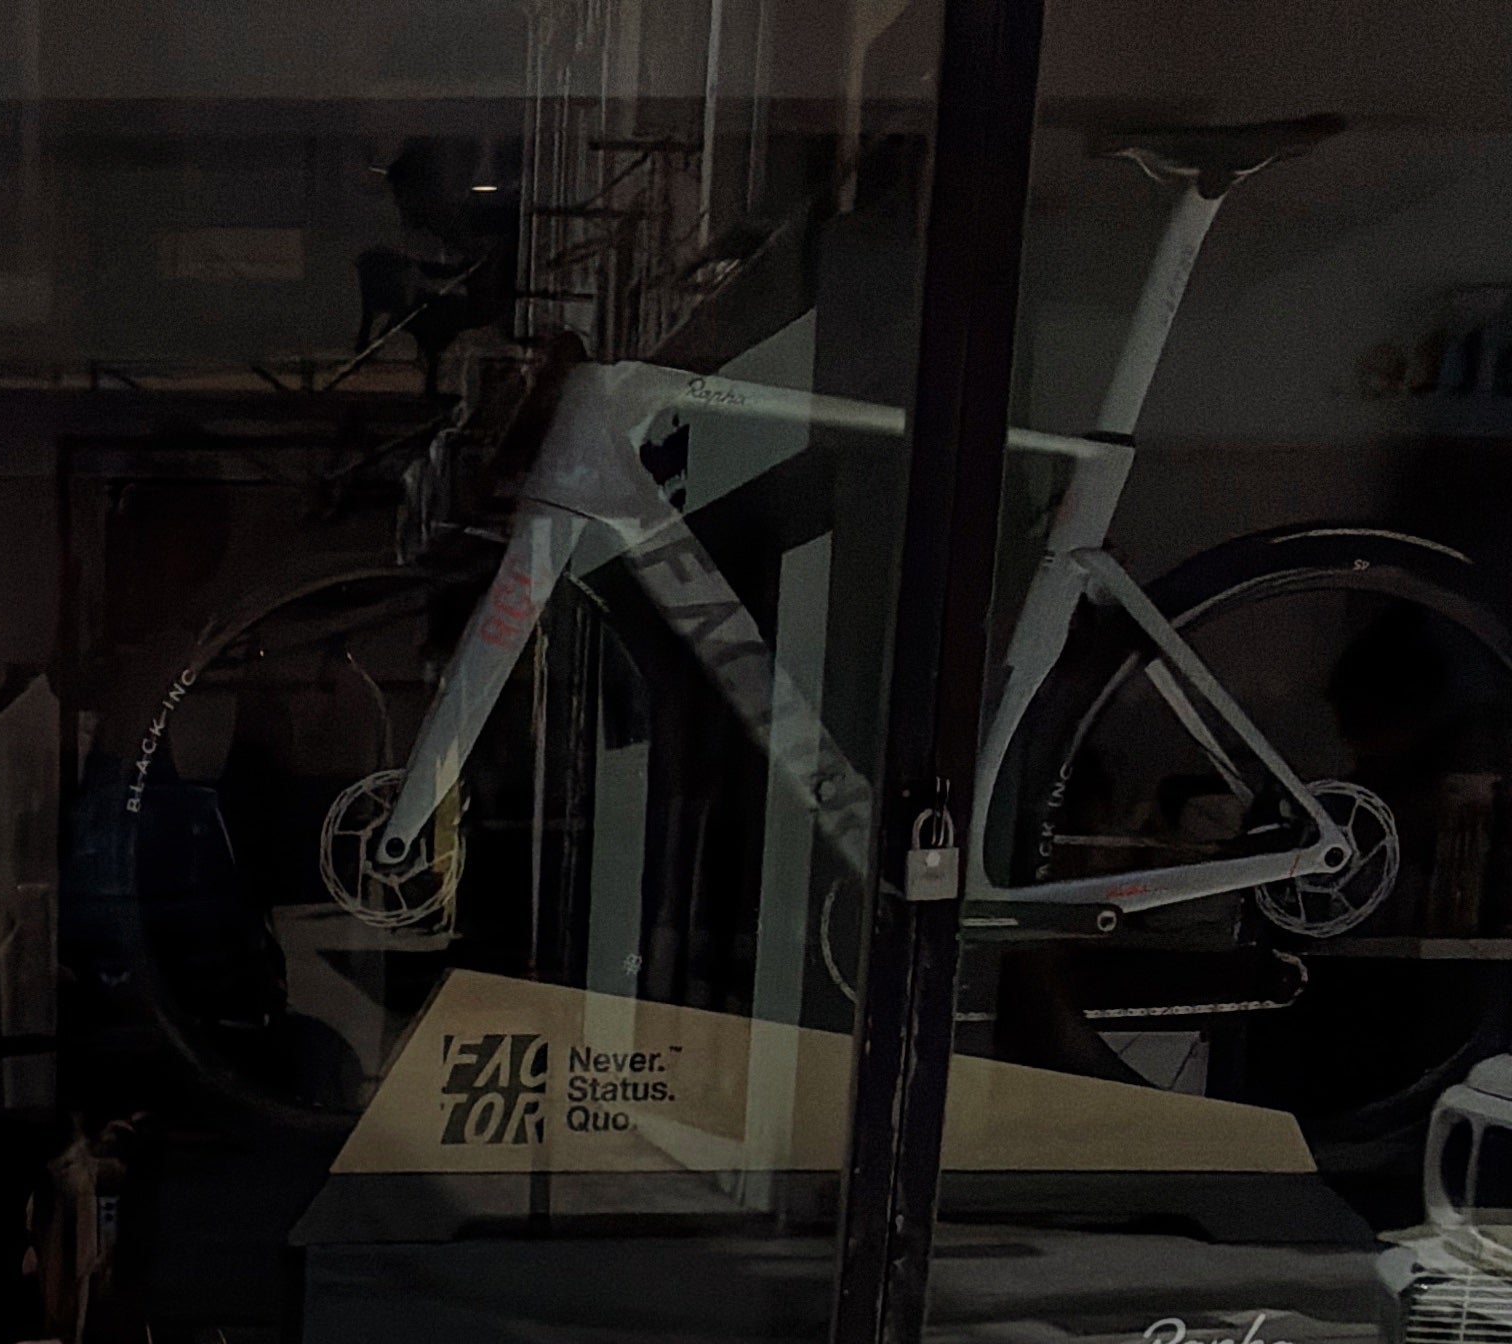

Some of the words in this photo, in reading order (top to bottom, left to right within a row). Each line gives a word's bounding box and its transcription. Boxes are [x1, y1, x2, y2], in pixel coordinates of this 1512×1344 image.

[126, 718, 164, 813] BLACK
[162, 668, 196, 711] INC
[1035, 821, 1055, 880] ACK
[1048, 761, 1073, 808] INC
[568, 1076, 675, 1101] Status.
